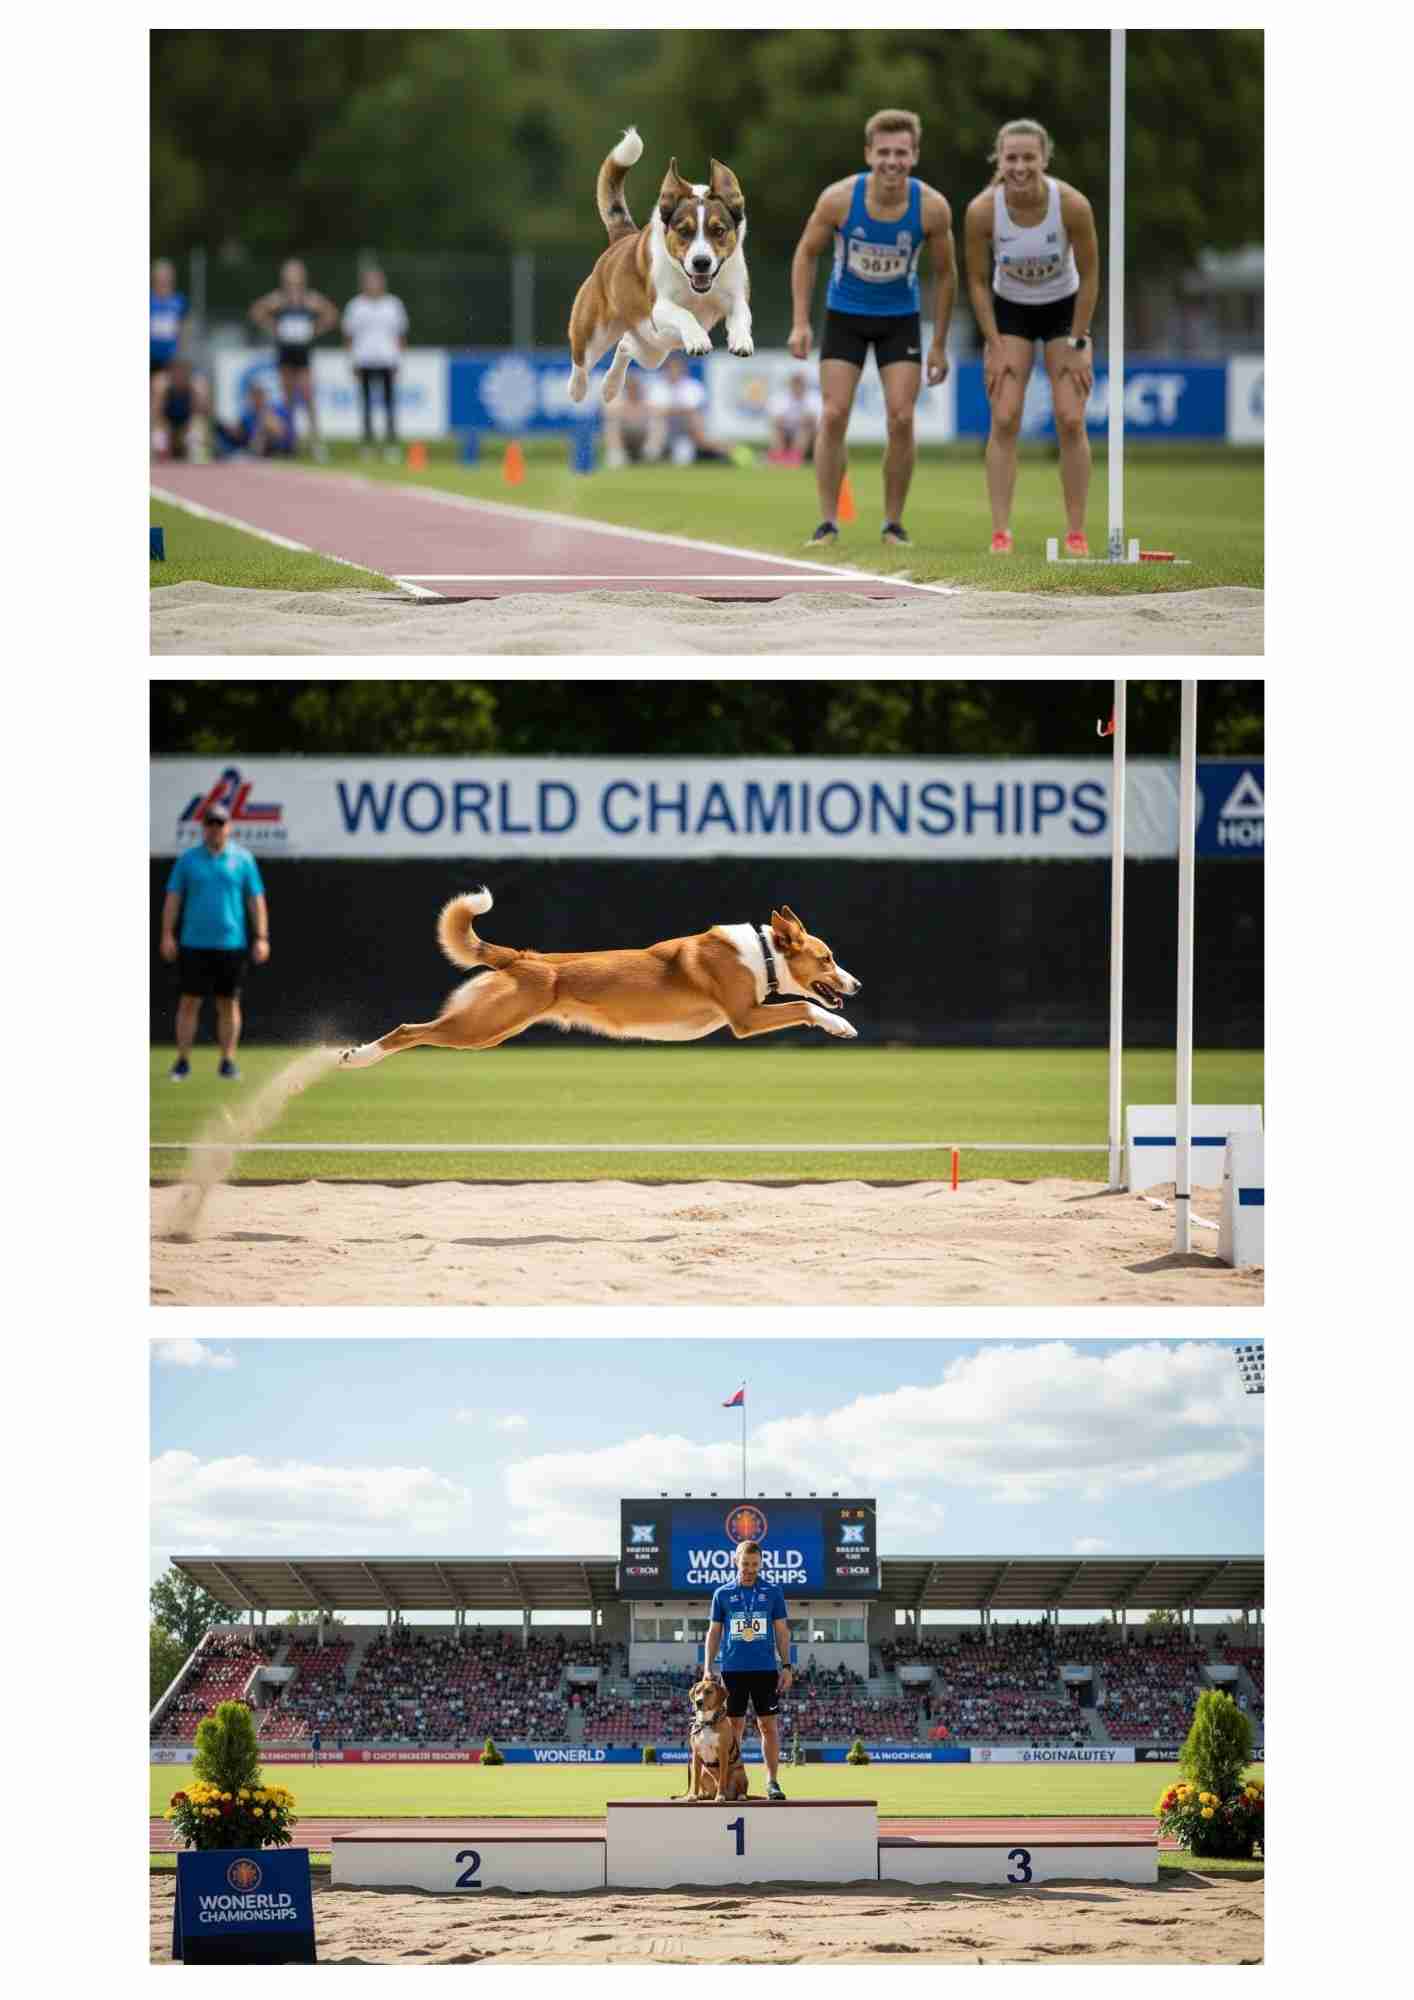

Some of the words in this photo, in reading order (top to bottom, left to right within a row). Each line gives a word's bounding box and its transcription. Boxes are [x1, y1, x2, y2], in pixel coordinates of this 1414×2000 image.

[336, 780, 578, 835] WORLD
[600, 780, 1108, 836] CHAMIONSHIPS
[533, 1749, 606, 1762] WONERLD
[726, 1817, 746, 1856] 1
[455, 1850, 482, 1888] 2
[1007, 1848, 1033, 1884] 3
[198, 1893, 292, 1910] WONERLD
[199, 1907, 297, 1923] CHAMIONSHPS
